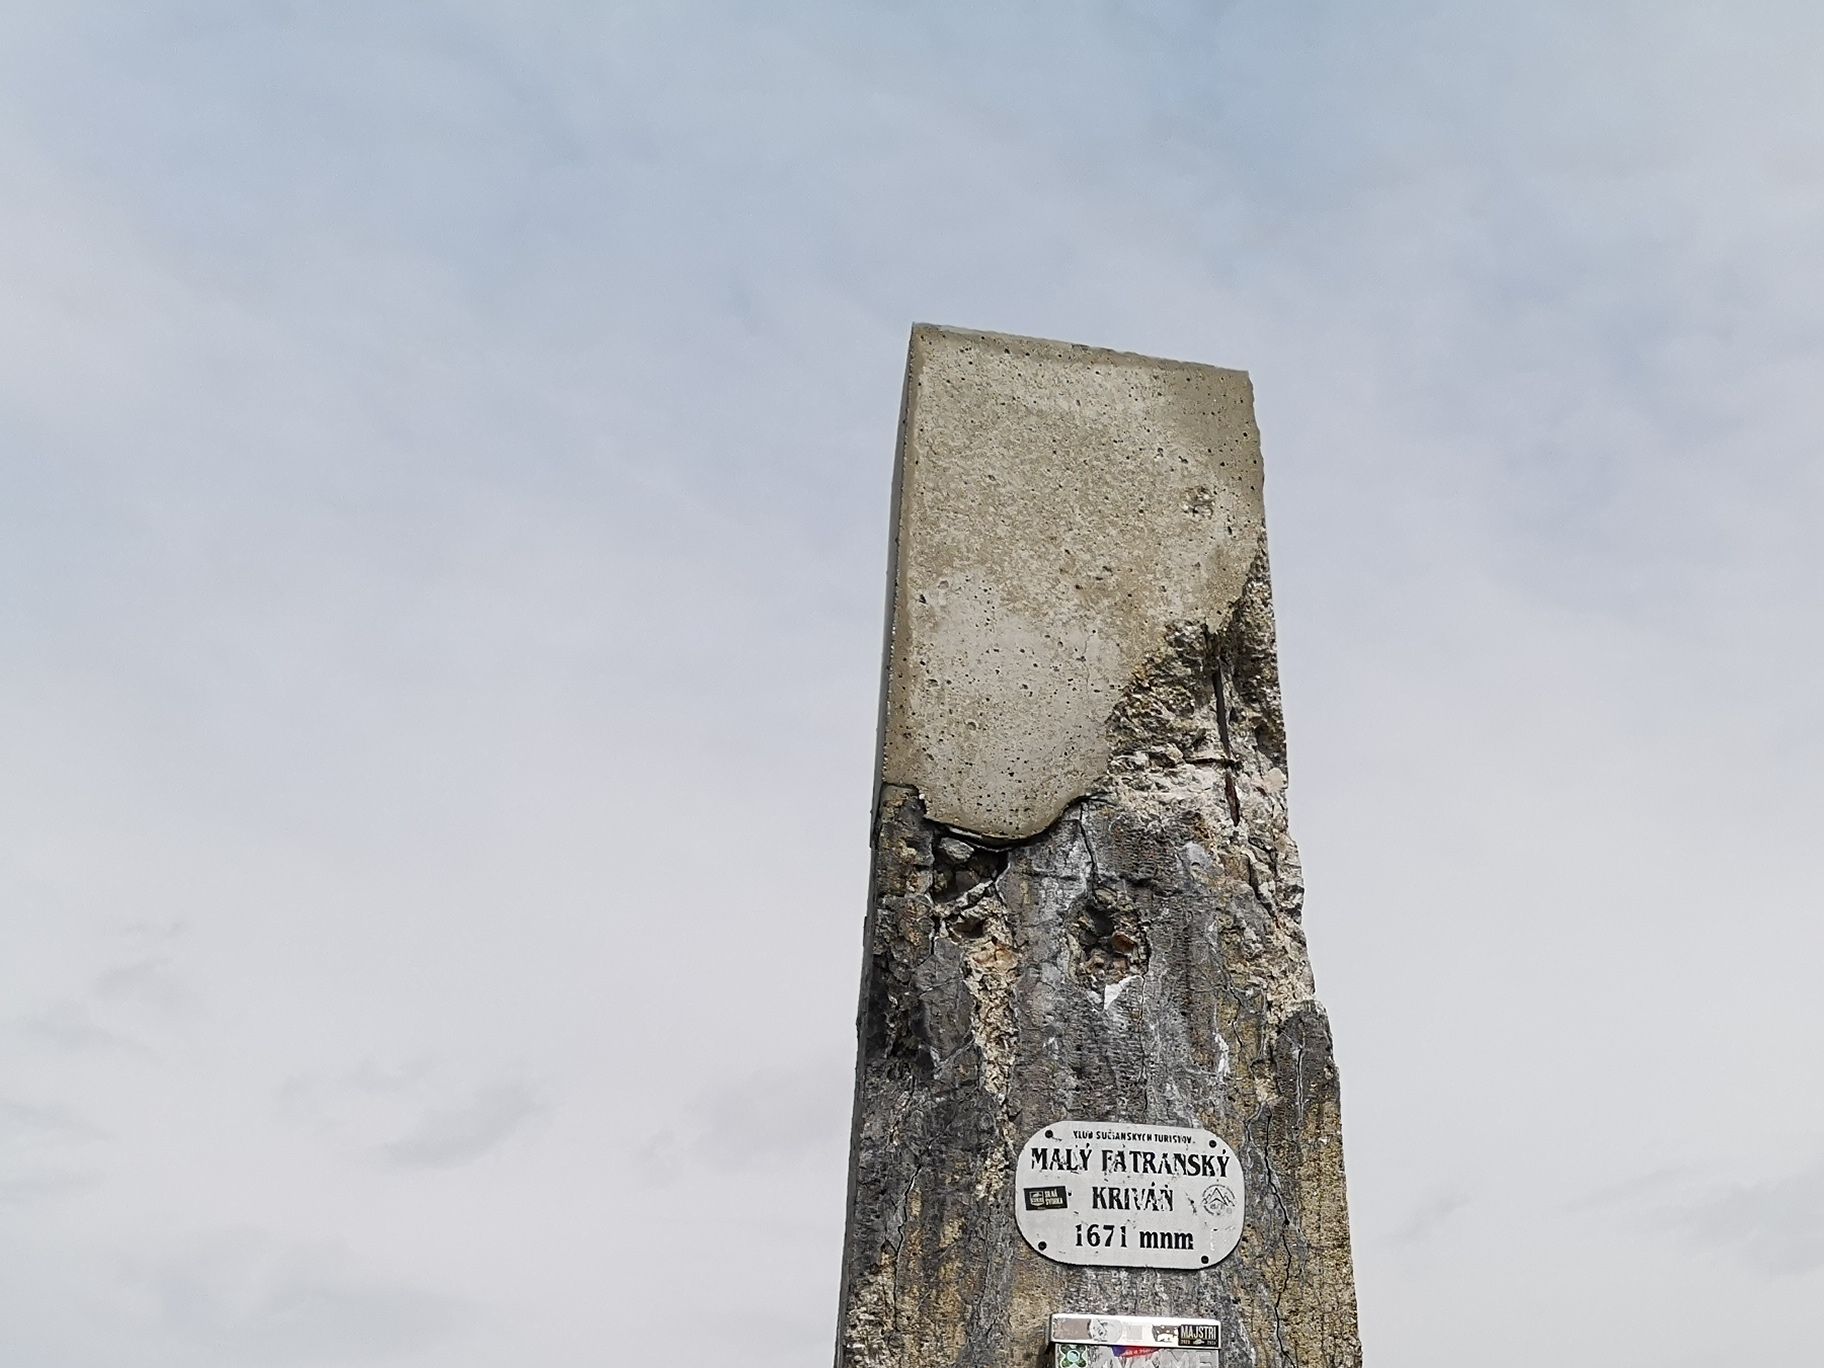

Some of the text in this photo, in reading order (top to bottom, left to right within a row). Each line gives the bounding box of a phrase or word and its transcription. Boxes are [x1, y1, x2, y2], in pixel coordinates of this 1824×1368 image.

[1031, 1142, 1230, 1178] MALÝ FATRANSKÝ
[1075, 1224, 1194, 1250] 1671 mnm
[1180, 1325, 1216, 1340] MAJSTRI
